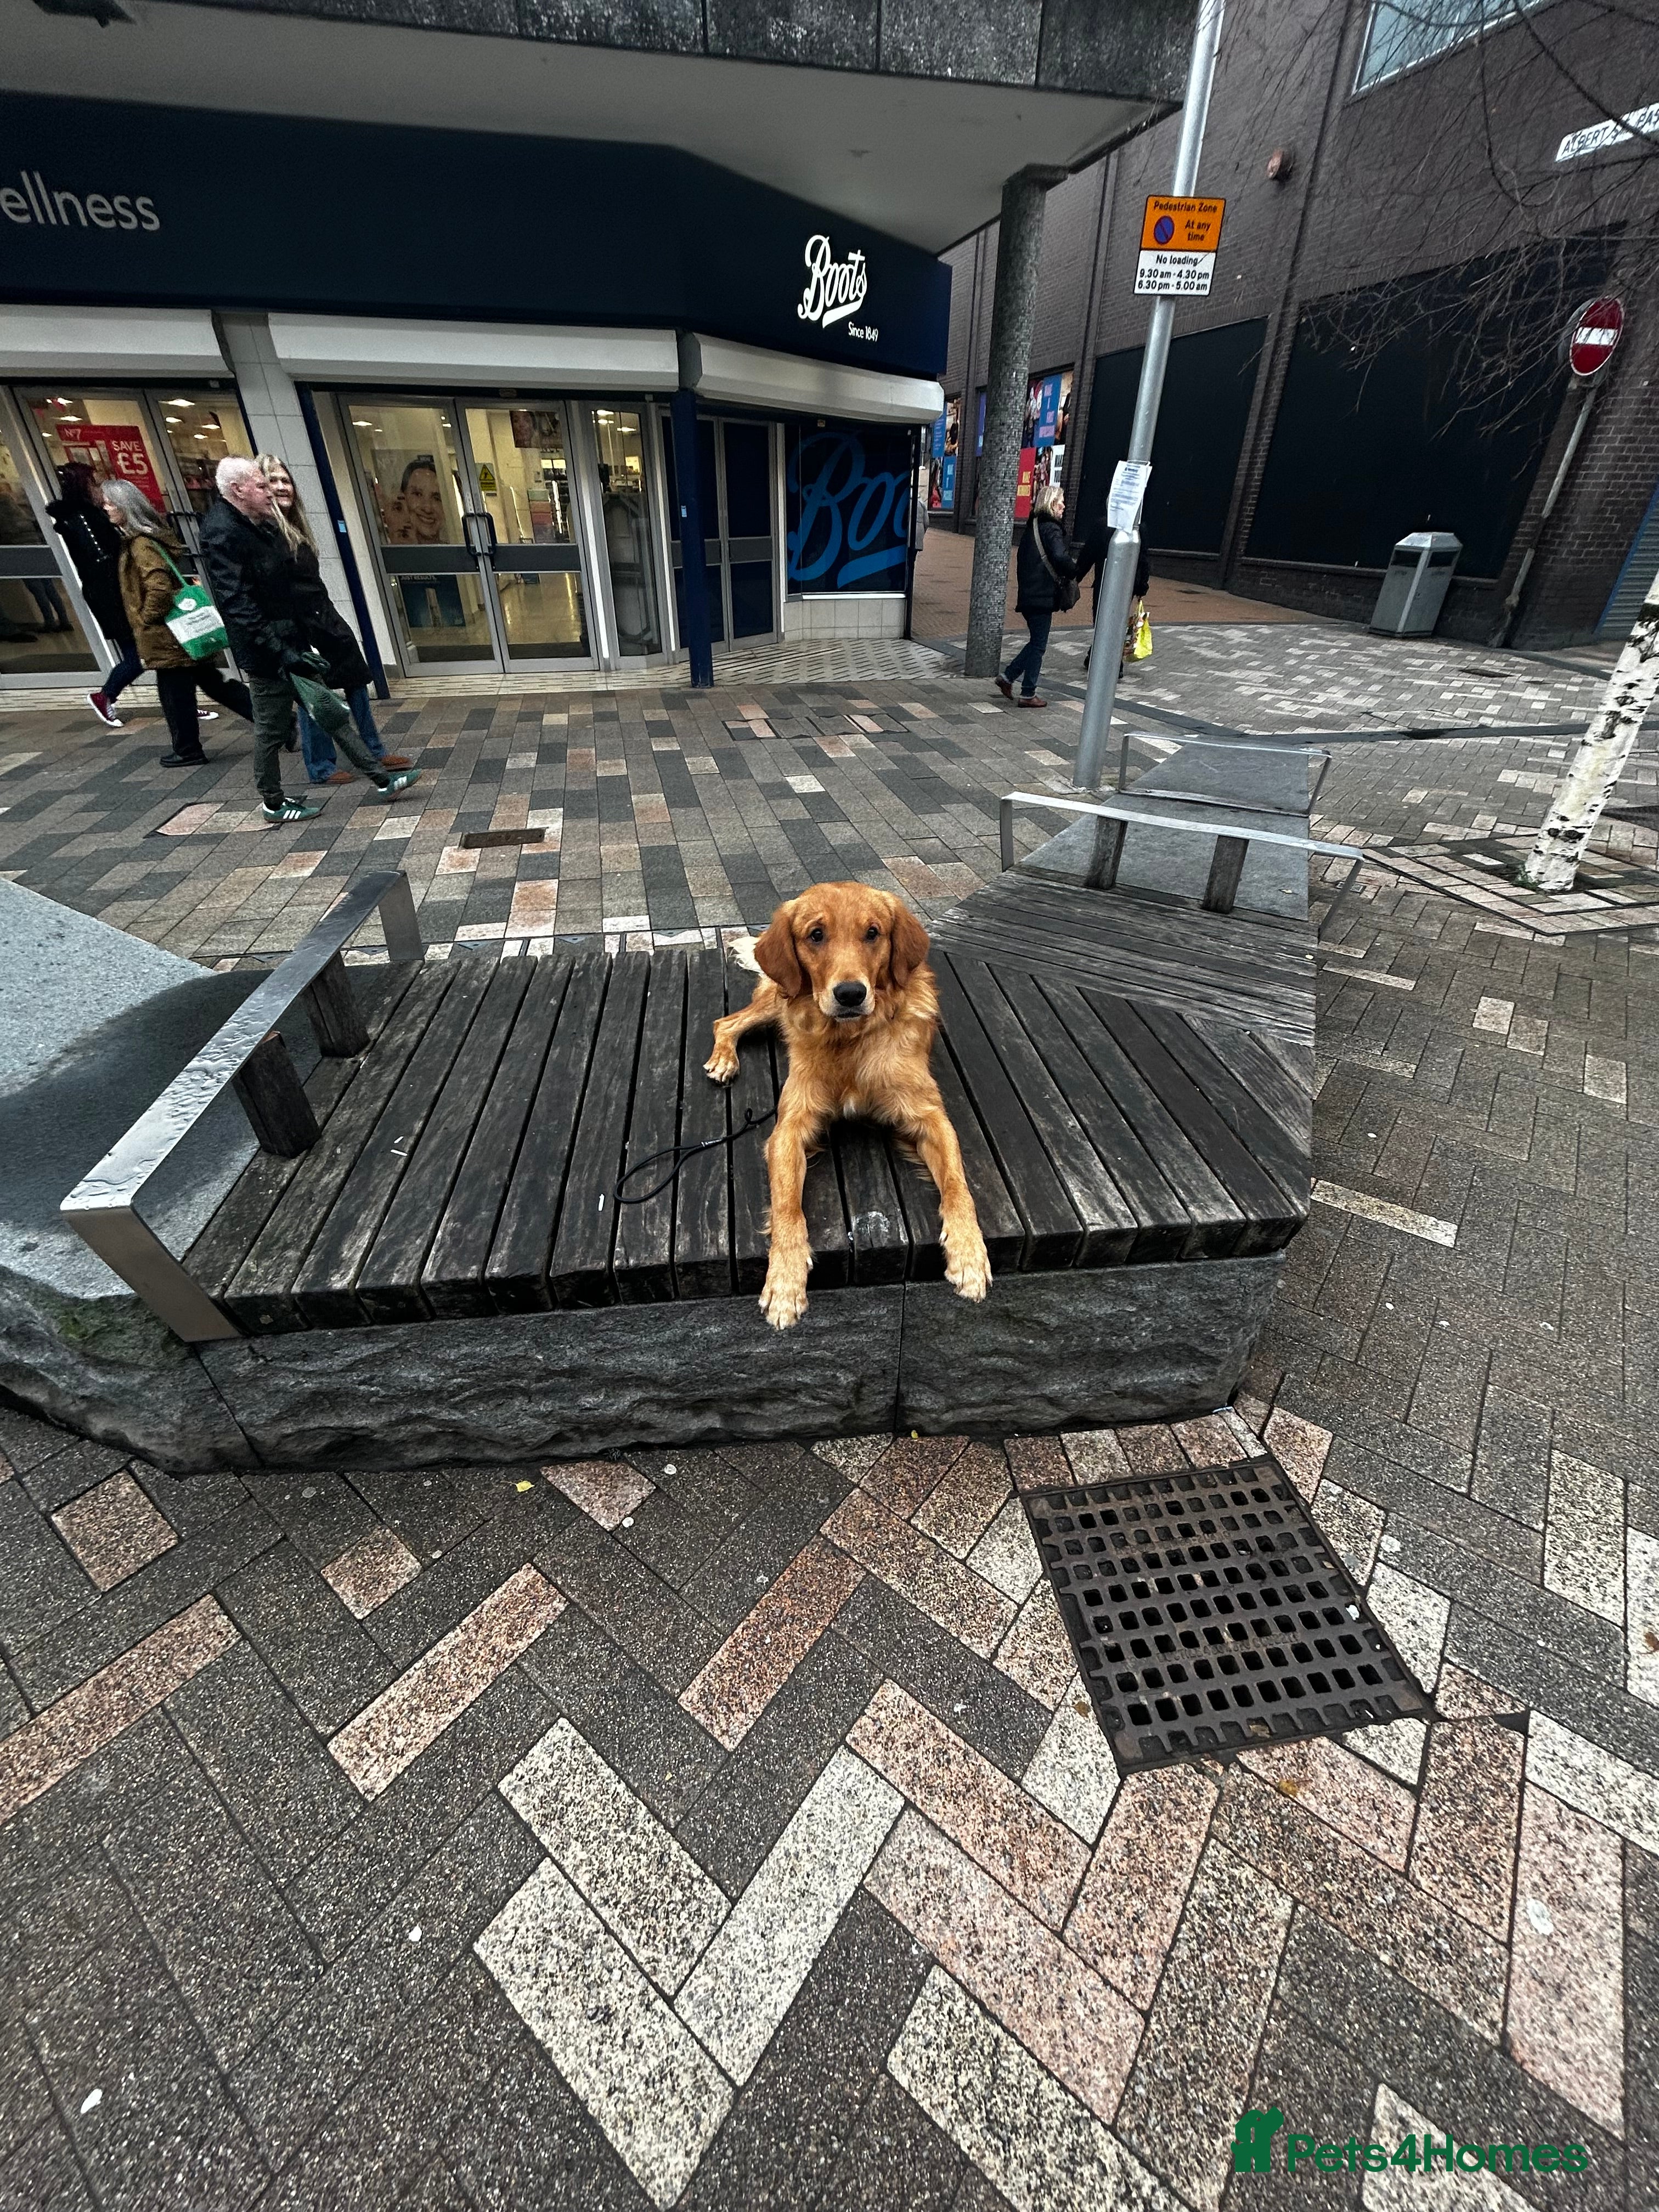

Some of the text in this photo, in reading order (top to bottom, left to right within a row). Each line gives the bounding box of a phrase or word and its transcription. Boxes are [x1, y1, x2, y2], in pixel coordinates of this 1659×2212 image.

[1561, 125, 1610, 156] ALBERT
[1154, 200, 1217, 213] Pedestrian Zone
[1185, 219, 1211, 232] At any
[1188, 232, 1205, 241] time
[1156, 254, 1198, 267] No loading
[1140, 268, 1159, 278] 9.30
[1177, 269, 1197, 279] 4.30
[1197, 272, 1209, 281] pm
[798, 235, 867, 328] Boots
[1138, 280, 1157, 289] 6.30
[1158, 282, 1170, 291] pm
[1176, 281, 1195, 291] 5.00
[848, 321, 879, 342] Since 1849
[111, 440, 143, 452] SAVE
[117, 452, 149, 475] £5
